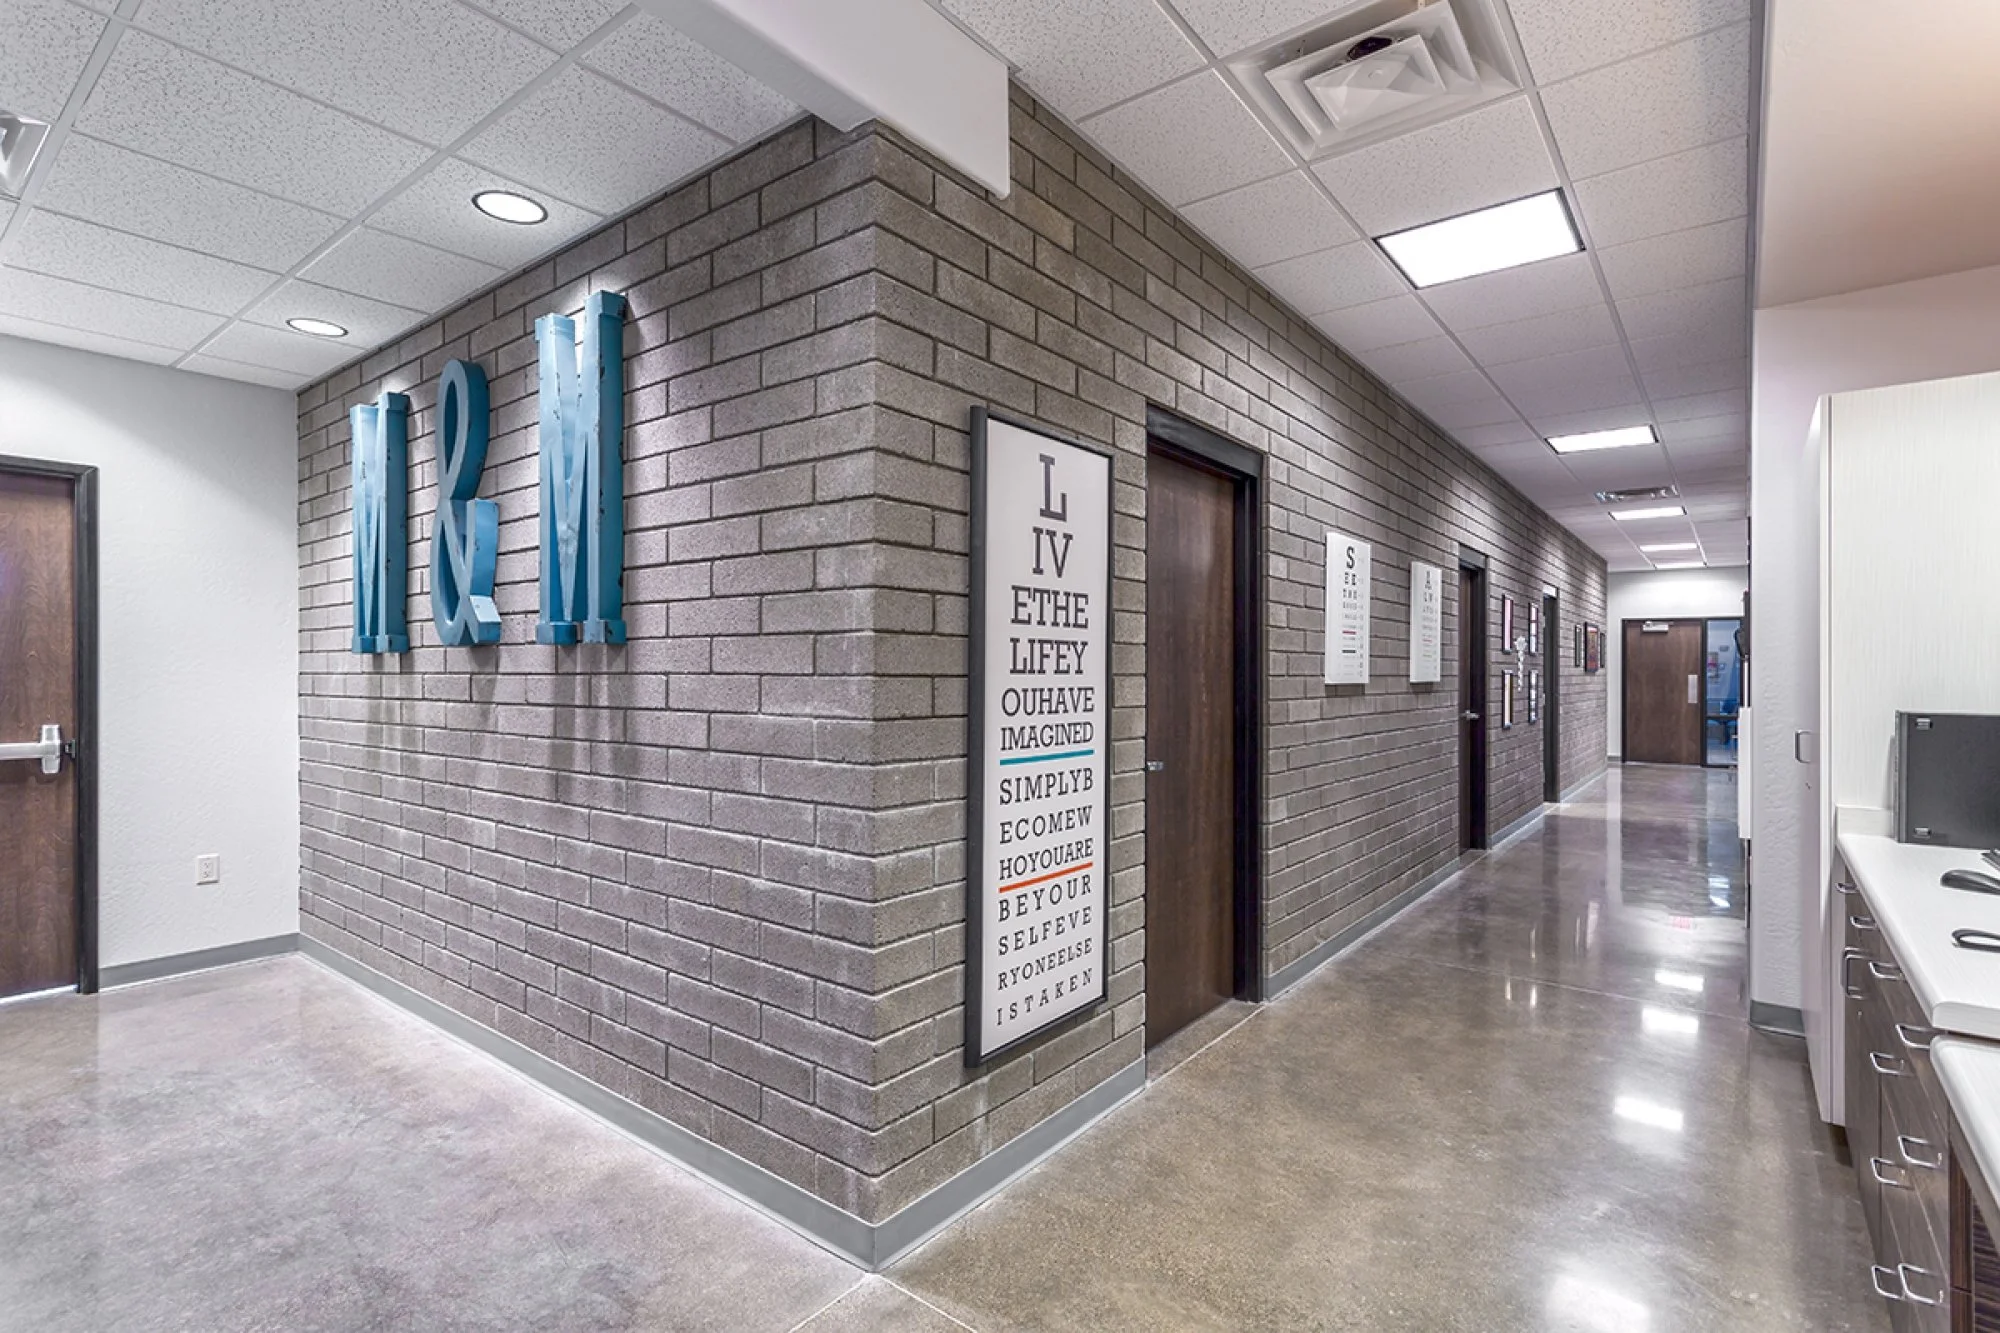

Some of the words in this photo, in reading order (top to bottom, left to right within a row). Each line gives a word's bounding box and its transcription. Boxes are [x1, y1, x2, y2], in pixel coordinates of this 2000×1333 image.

[430, 359, 502, 647] &
[534, 289, 628, 645] M
[1039, 453, 1067, 522] L
[1032, 526, 1073, 578] IV
[1346, 545, 1355, 569] S
[1011, 585, 1089, 629] ETHE
[1009, 637, 1088, 675] LIFEY
[1001, 686, 1094, 717] OUHAVE
[1000, 721, 1094, 751] IMAGINED
[999, 767, 1093, 806] SIMPLYB
[999, 805, 1093, 844] ECOMEW
[999, 838, 1093, 881] HOYOUARE
[998, 874, 1092, 922] BEYOUR
[998, 905, 1092, 956] SELFEVE
[997, 937, 1092, 991] RYONEELSE
[996, 967, 1092, 1026] ISTAKEN
